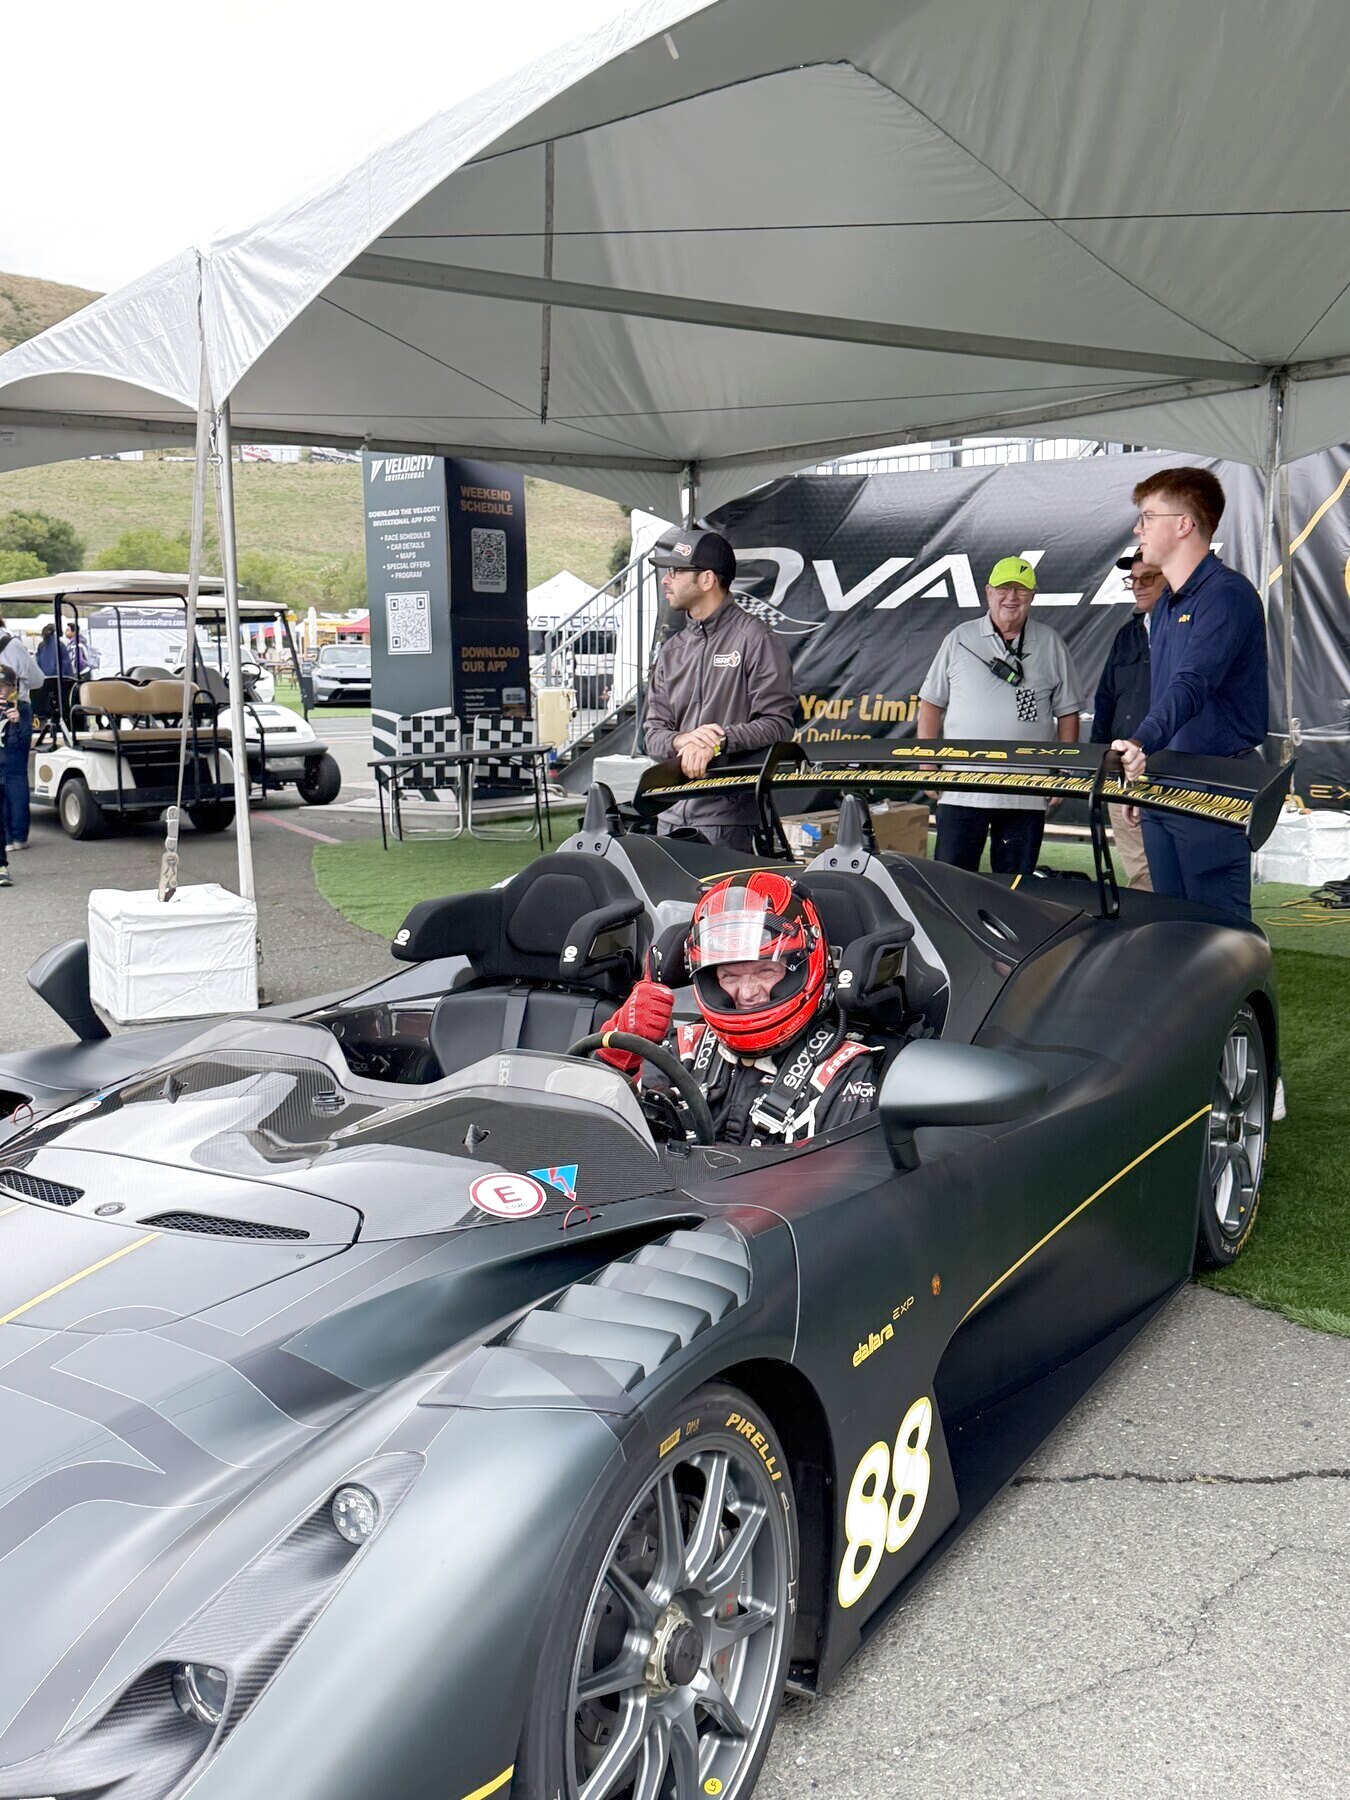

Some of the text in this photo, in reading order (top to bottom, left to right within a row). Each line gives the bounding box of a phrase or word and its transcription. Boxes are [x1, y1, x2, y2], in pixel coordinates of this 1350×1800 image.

[385, 455, 434, 474] VELOCITY
[385, 471, 424, 482] INVITATIONAL
[460, 486, 511, 501] WEEKEND
[368, 509, 399, 518] DOWNLOAD
[413, 505, 441, 514] VELOCITY
[460, 500, 513, 515] SCHEDULE
[373, 518, 410, 527] INVITATIONAL
[400, 531, 431, 540] SCHEDULES
[461, 647, 520, 658] DOWNLOAD
[462, 661, 508, 672] OUR APP
[800, 694, 921, 721] Your Limi
[891, 746, 1080, 759] dallara EXP
[697, 1030, 717, 1069] arco
[826, 1045, 860, 1074] HRX
[493, 1186, 522, 1204] E
[852, 1296, 915, 1368] dallara EXP
[725, 1412, 782, 1481] PIRELLI
[838, 1397, 933, 1608] 88
